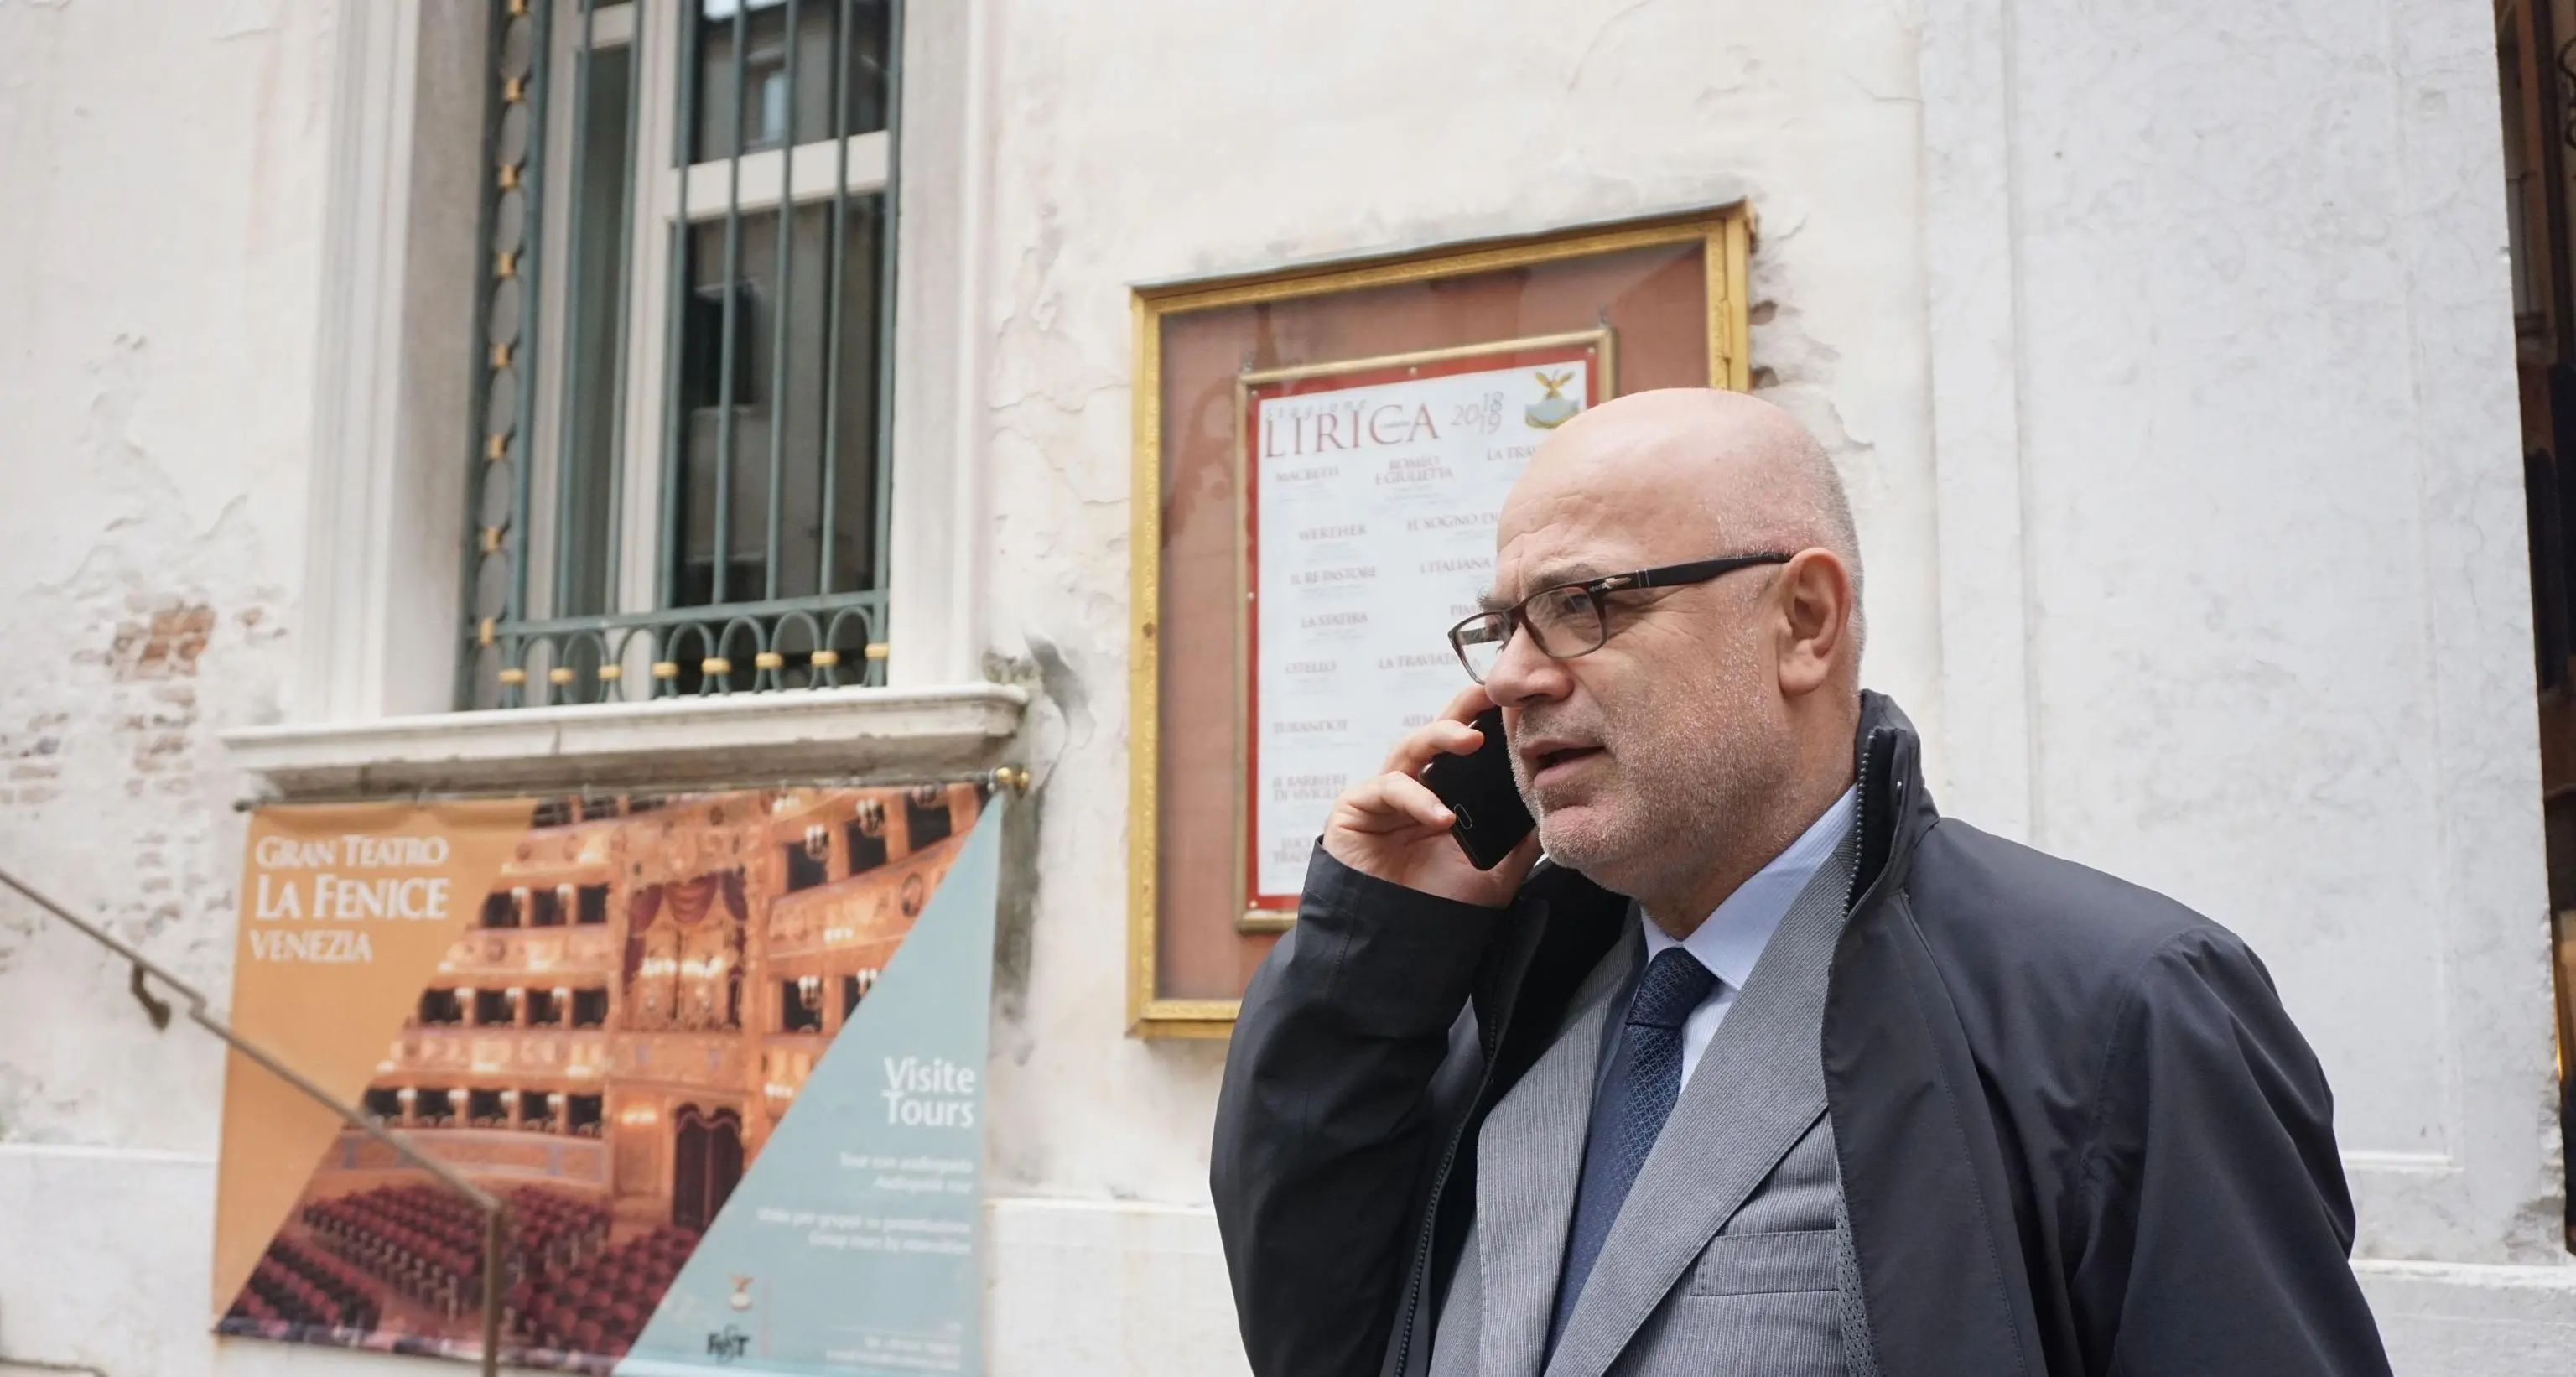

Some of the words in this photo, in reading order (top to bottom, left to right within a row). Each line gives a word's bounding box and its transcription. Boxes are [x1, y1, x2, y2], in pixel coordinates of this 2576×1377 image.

[1265, 403, 1441, 458] LIRICA
[1487, 449, 1503, 461] LA
[1276, 465, 1339, 482] MACBETH
[1384, 467, 1453, 484] GIULIETTA
[1407, 519, 1420, 532] IL
[1423, 513, 1478, 529] SOGNO
[1298, 524, 1367, 540] WERTHER
[1322, 565, 1377, 582] PASTORE
[1301, 616, 1316, 628] LA
[1285, 660, 1337, 674] OTELLO
[1379, 657, 1394, 669] LA
[1273, 719, 1350, 734] TURANDOT
[256, 836, 334, 867] GRAN
[344, 835, 449, 866] TEATRO
[256, 874, 301, 919] LA
[312, 874, 450, 919] FENICE
[250, 930, 373, 963] VENEZIA
[885, 1057, 975, 1093] Visite
[880, 1090, 975, 1129] Tours
